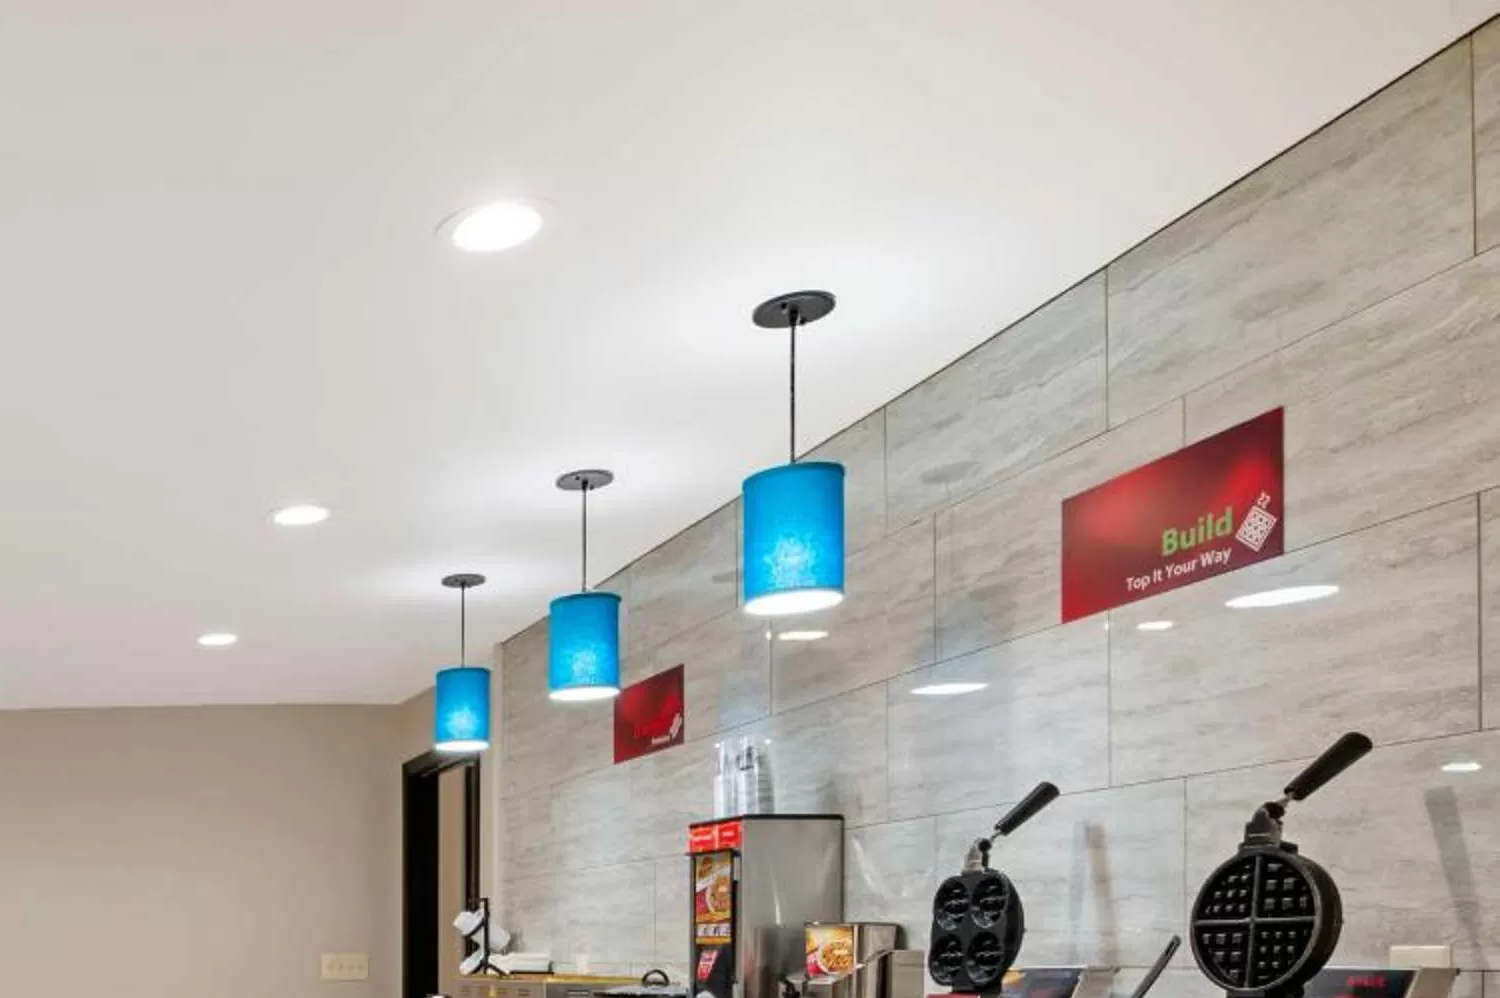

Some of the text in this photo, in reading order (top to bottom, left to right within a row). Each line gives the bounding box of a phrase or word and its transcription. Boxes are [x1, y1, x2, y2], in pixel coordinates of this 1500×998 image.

[1163, 507, 1232, 556] Build
[1126, 548, 1232, 591] Top It Your Way
